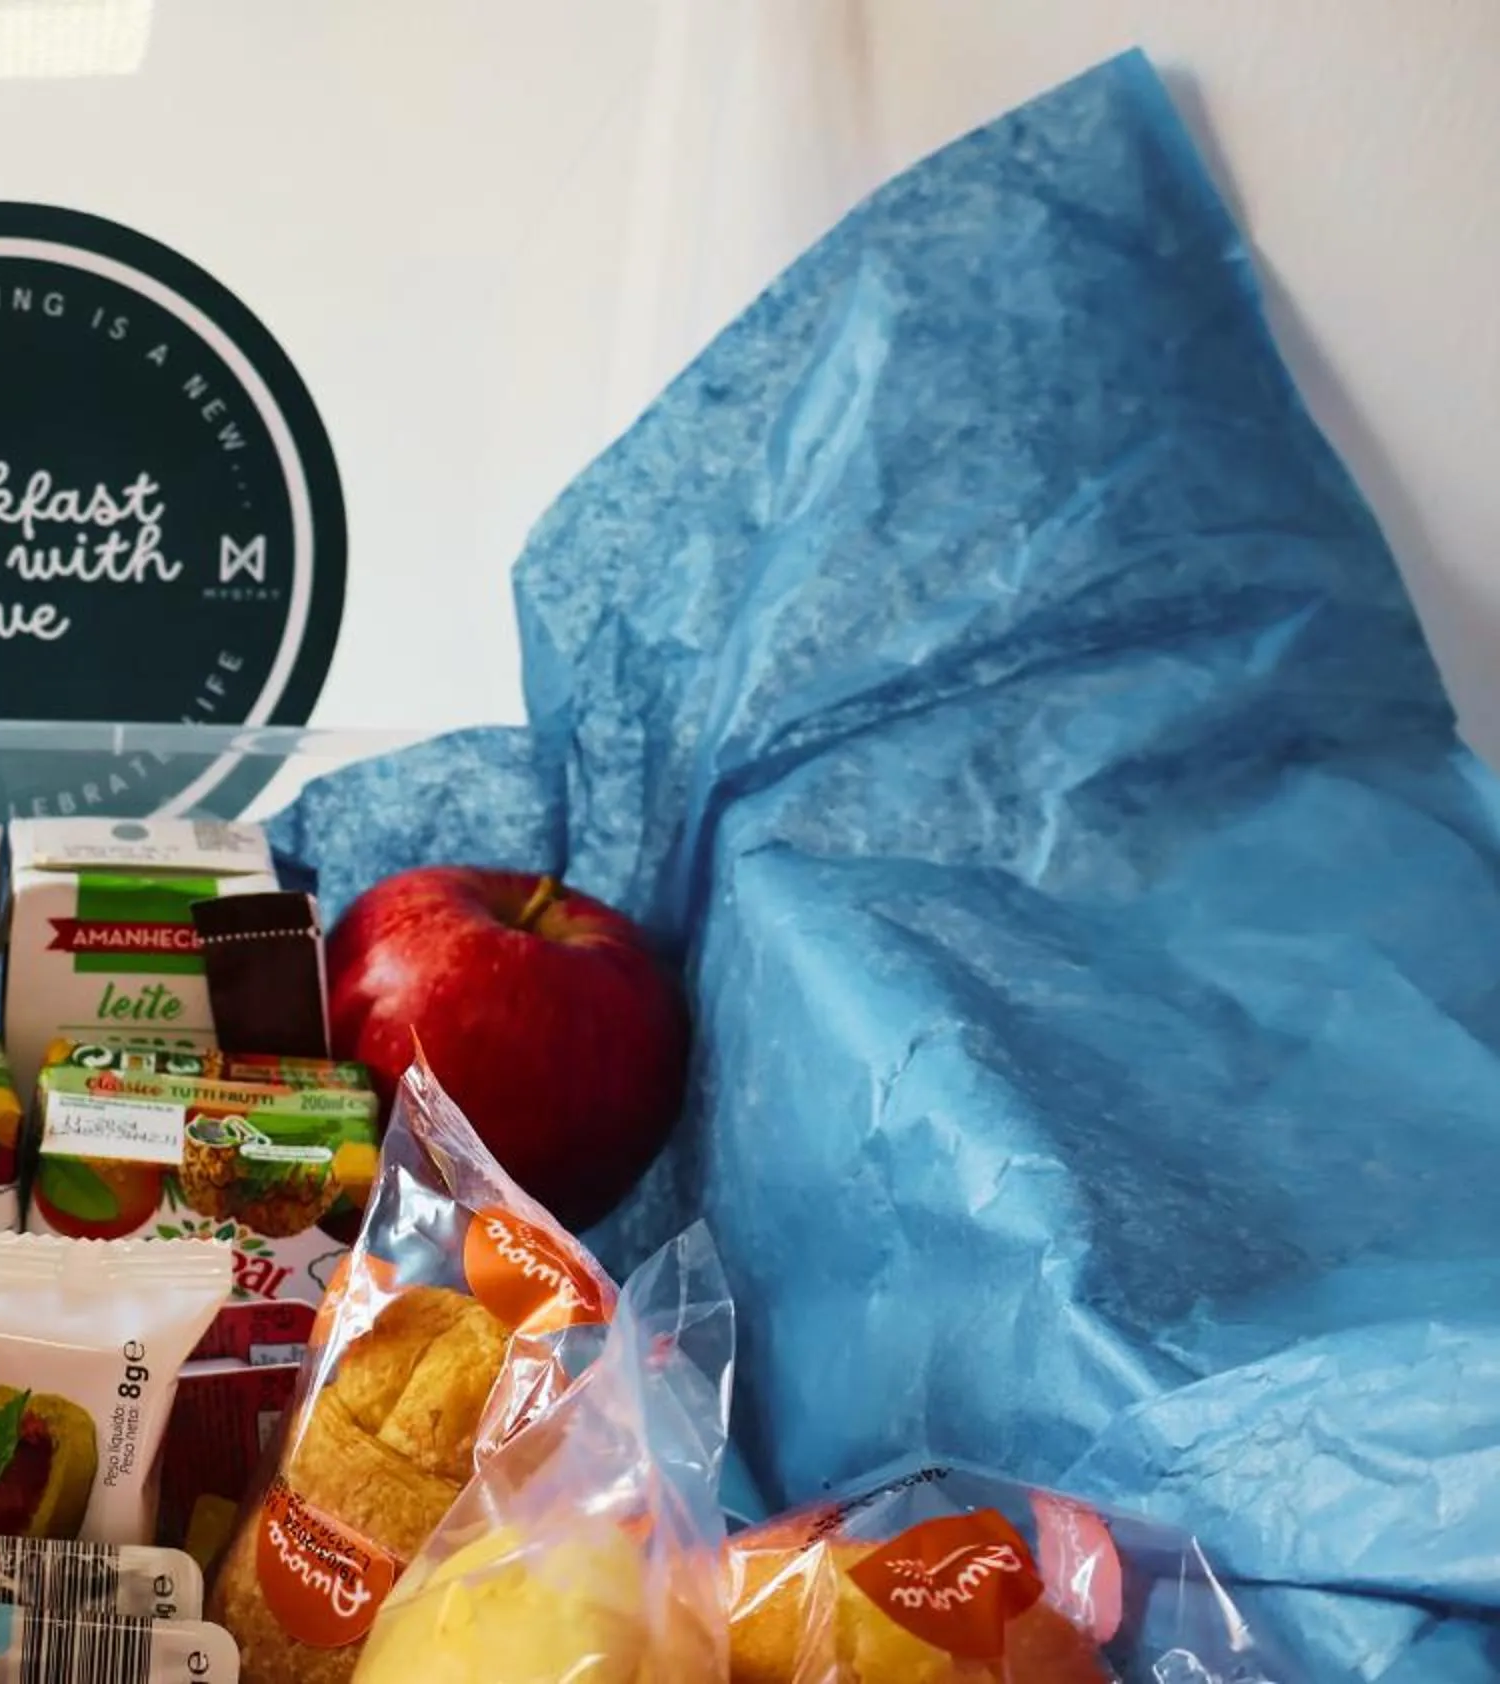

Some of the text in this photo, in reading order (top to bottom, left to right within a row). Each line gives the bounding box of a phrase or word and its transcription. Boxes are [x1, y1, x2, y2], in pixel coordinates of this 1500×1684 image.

[90, 306, 130, 340] IS
[145, 343, 169, 367] A
[182, 373, 246, 451] NEW
[5, 521, 184, 583] with
[72, 927, 202, 950] AMANHEC
[97, 981, 184, 1021] leite
[484, 1216, 598, 1312] Aurora
[103, 1454, 119, 1488] Peso
[120, 1442, 136, 1475] Peso
[267, 1519, 372, 1618] Aurora
[889, 1543, 1023, 1611] Aurra
